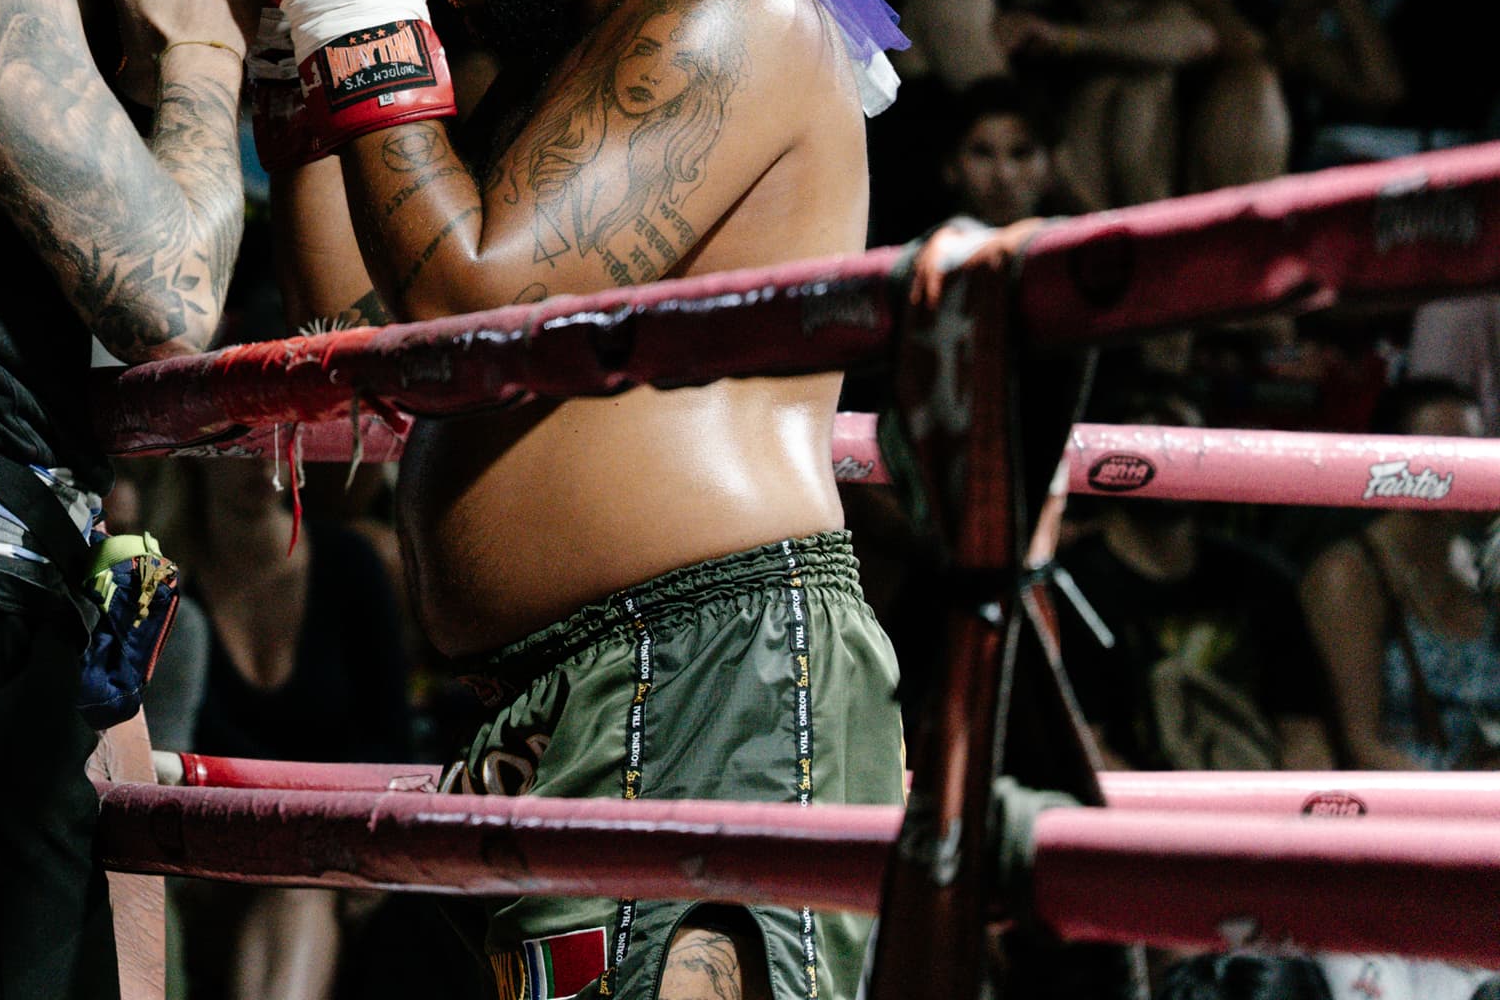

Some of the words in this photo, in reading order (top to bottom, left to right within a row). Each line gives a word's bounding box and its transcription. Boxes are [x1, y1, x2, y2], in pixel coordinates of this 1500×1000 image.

[344, 71, 371, 91] S.K.
[1362, 460, 1454, 500] Fairtex
[790, 588, 804, 622] BOXING
[794, 625, 806, 649] THAI
[640, 645, 651, 680] BOXING
[631, 705, 642, 728] THAI
[798, 690, 809, 726] BOXING
[630, 731, 641, 767] BOXING
[799, 731, 809, 754] THAI
[620, 905, 632, 929] THAI
[615, 932, 627, 966] OXING
